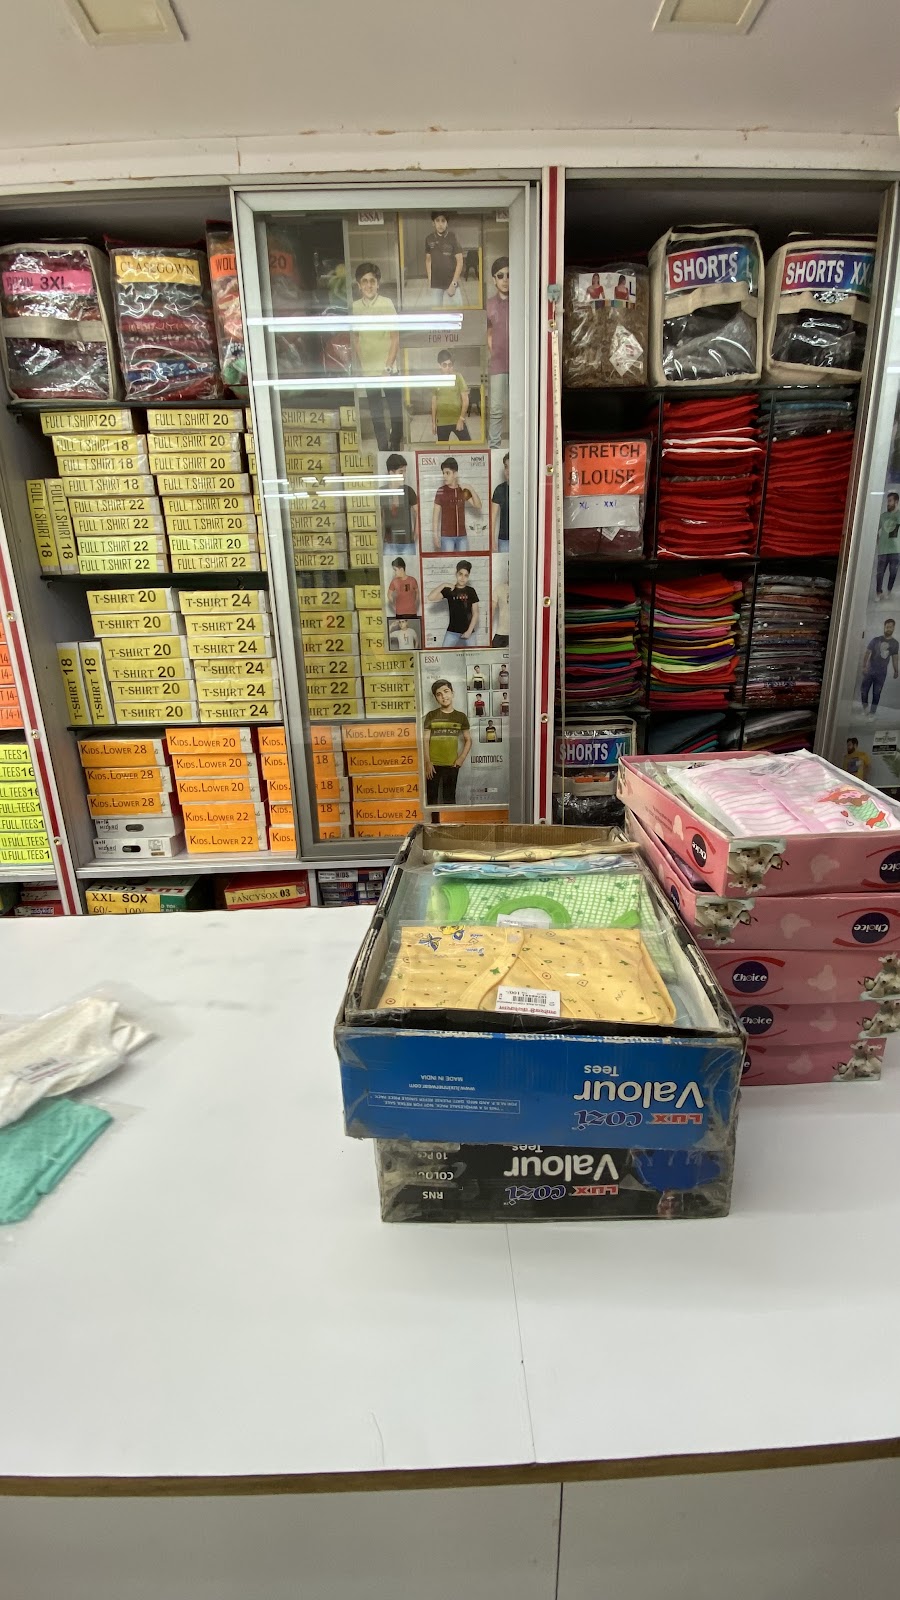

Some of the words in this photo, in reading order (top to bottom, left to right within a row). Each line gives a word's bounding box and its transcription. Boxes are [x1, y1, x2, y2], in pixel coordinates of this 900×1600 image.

[271, 255, 287, 268] 20
[672, 253, 738, 283] SHORTS
[786, 260, 844, 284] SHORTS
[40, 276, 72, 290] 3XL
[46, 416, 65, 427] FULL
[67, 415, 98, 426] T.SHIRT
[99, 414, 116, 426] 20
[155, 415, 175, 425] FULL
[178, 414, 209, 424] T.SHIRT
[214, 413, 229, 424] 20
[569, 445, 640, 458] STRETCH
[155, 459, 174, 469] FULL
[176, 458, 207, 469] T.SHIRT
[210, 457, 225, 468] 20
[163, 479, 183, 489] FULL
[185, 478, 216, 489] T.SHIRT
[219, 477, 235, 487] 20
[30, 482, 40, 503] FULL
[74, 501, 92, 512] FULL
[96, 499, 126, 510] T.SHIRT
[129, 499, 145, 509] 22
[169, 501, 188, 511] FULL
[190, 499, 220, 510] T.SHIRT
[224, 497, 239, 508] 20
[33, 508, 49, 539] T.SHIRT
[50, 484, 61, 505] FULL
[61, 545, 74, 559] 18
[79, 520, 98, 531] FULL
[100, 519, 131, 529] T.SHIRT
[133, 518, 149, 528] 22
[40, 542, 53, 557] 18
[80, 541, 99, 552] FULL
[102, 540, 131, 551] T.SHIRT
[134, 540, 150, 551] 22
[81, 561, 100, 571] FULL
[102, 560, 132, 570] T.SHIRT
[135, 559, 150, 569] 22
[178, 559, 197, 569] FULL
[198, 558, 228, 568] T.SHIRT
[231, 557, 246, 567] 22
[93, 593, 134, 603] T-SHIRT
[138, 590, 156, 602] 20
[186, 598, 228, 607] T-SHIRT
[232, 594, 251, 607] 24
[109, 648, 150, 657] T-SHIRT
[153, 644, 171, 656] 20
[193, 644, 234, 653] T-SHIRT
[238, 640, 257, 652] 24
[85, 658, 96, 674] 18
[366, 661, 406, 671] T-SHIRT
[424, 656, 439, 664] ESSA
[61, 658, 73, 675] 18
[114, 669, 154, 678] T-SHIRT
[157, 666, 175, 677] 20
[203, 688, 243, 697] T-SHIRT
[247, 684, 265, 696] 24
[371, 684, 409, 692] T-SHIRT
[68, 679, 83, 719] T-SHIRT
[91, 679, 104, 719] T-SHIRT
[372, 701, 410, 709] T-SHIRT
[121, 708, 161, 717] T-SHIRT
[166, 706, 183, 717] 20
[205, 708, 246, 717] T-SHIRT
[250, 704, 268, 716] 24
[397, 728, 410, 736] 26
[223, 738, 235, 748] 20
[314, 736, 326, 745] 16
[134, 744, 147, 754] 28
[559, 743, 608, 761] SHORTS
[616, 742, 628, 759] XL
[229, 759, 241, 768] 20
[316, 755, 328, 764] 18
[401, 756, 413, 764] 26
[141, 770, 153, 779] 28
[232, 783, 243, 792] 20
[321, 781, 333, 789] 18
[407, 784, 418, 792] 24
[142, 798, 154, 807] 28
[321, 804, 332, 812] 18
[237, 812, 248, 821] 22
[406, 810, 417, 818] 24
[241, 836, 253, 845] 22
[92, 893, 115, 902] XXL
[122, 894, 147, 903] SOX
[232, 893, 278, 904] FANCYSOX
[279, 888, 290, 897] 03
[854, 923, 888, 932] Choice
[733, 973, 767, 982] Choice
[741, 1016, 773, 1024] Choice
[584, 1064, 619, 1077] Tees
[409, 1083, 475, 1091] www.luxinnerwear.com
[574, 1081, 704, 1109] Valour
[575, 1111, 642, 1131] cozi
[650, 1112, 703, 1125] LUX
[504, 1154, 619, 1181] Valour
[422, 1191, 443, 1199] RNS
[505, 1186, 566, 1206] cozi
[571, 1185, 618, 1196] LUX
